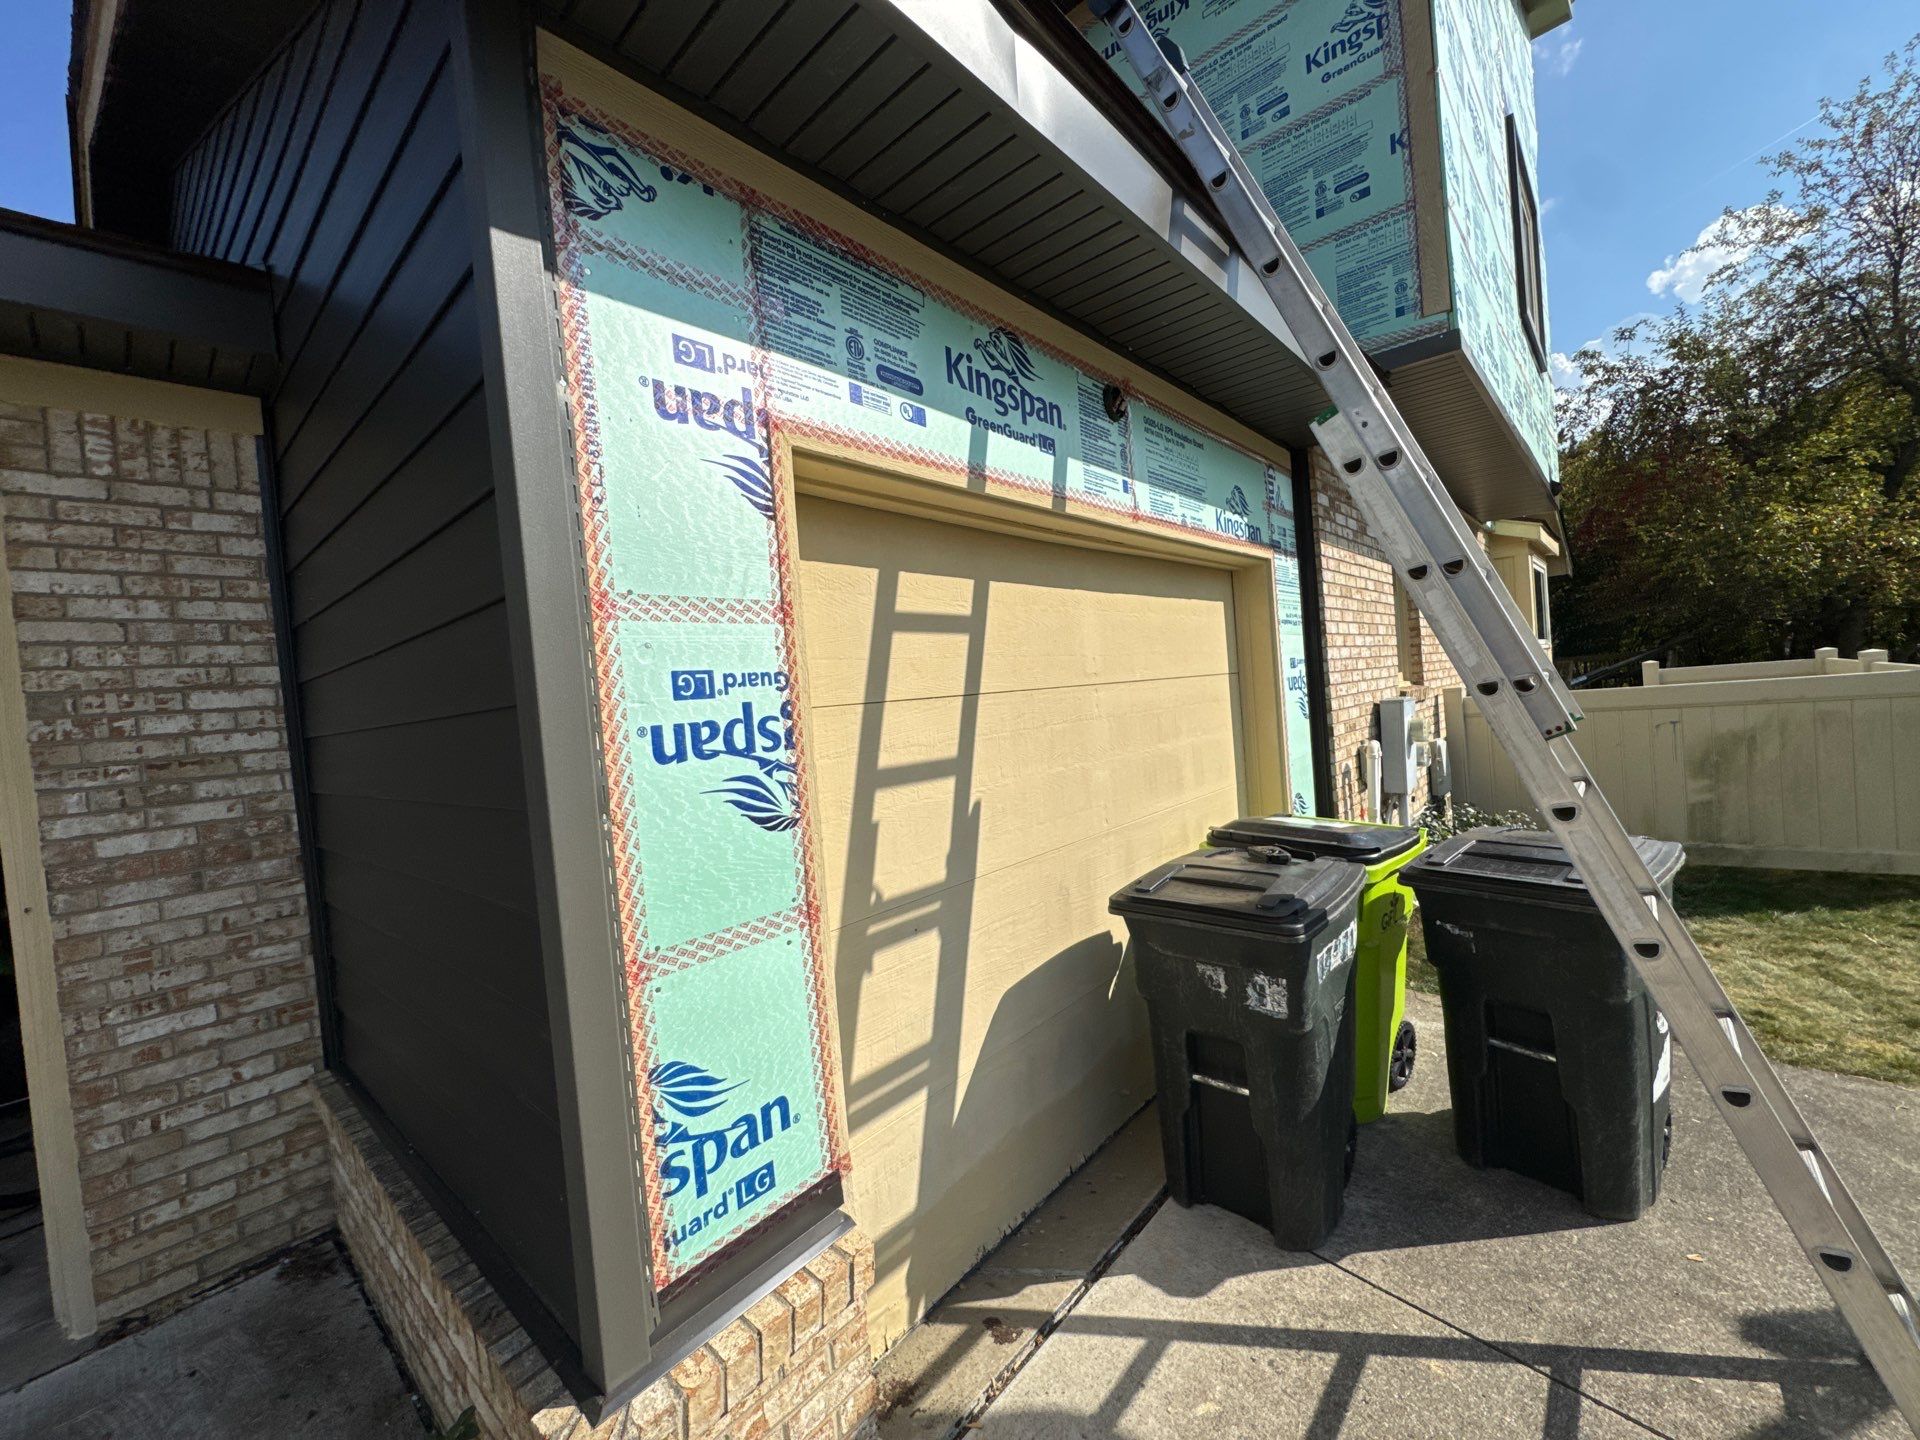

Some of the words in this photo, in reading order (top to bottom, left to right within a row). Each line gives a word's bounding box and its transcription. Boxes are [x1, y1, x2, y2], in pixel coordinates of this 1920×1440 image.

[945, 345, 1063, 430] Kingspan
[965, 406, 1036, 447] GreenGuard
[660, 1095, 792, 1200] span
[666, 1191, 730, 1249] uard
